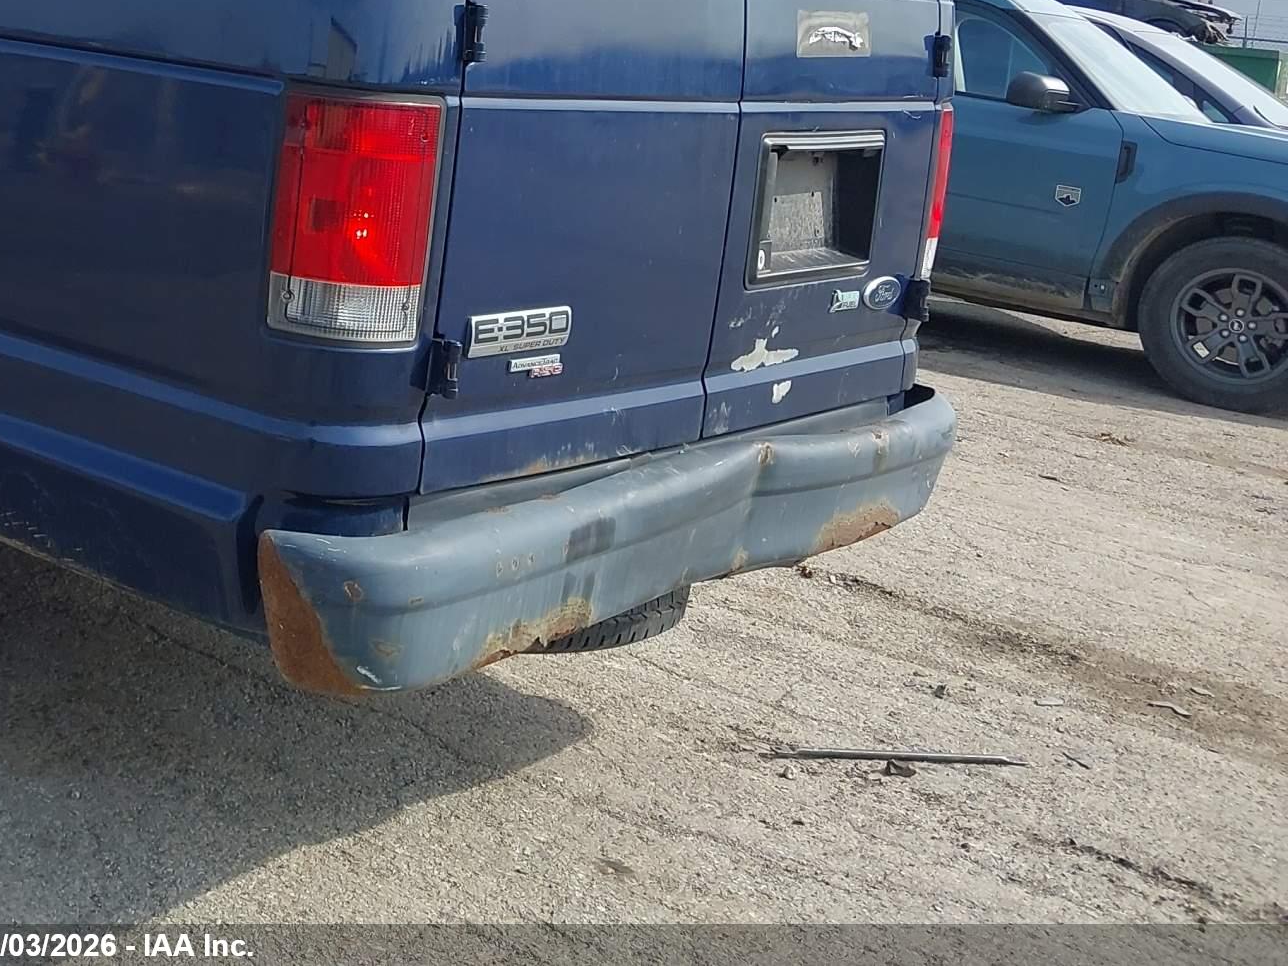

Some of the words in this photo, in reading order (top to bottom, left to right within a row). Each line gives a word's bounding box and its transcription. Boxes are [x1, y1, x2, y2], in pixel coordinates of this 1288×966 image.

[875, 284, 895, 302] Ford
[474, 310, 570, 344] E-350
[513, 340, 541, 351] SUPER
[542, 337, 565, 346] DUTY
